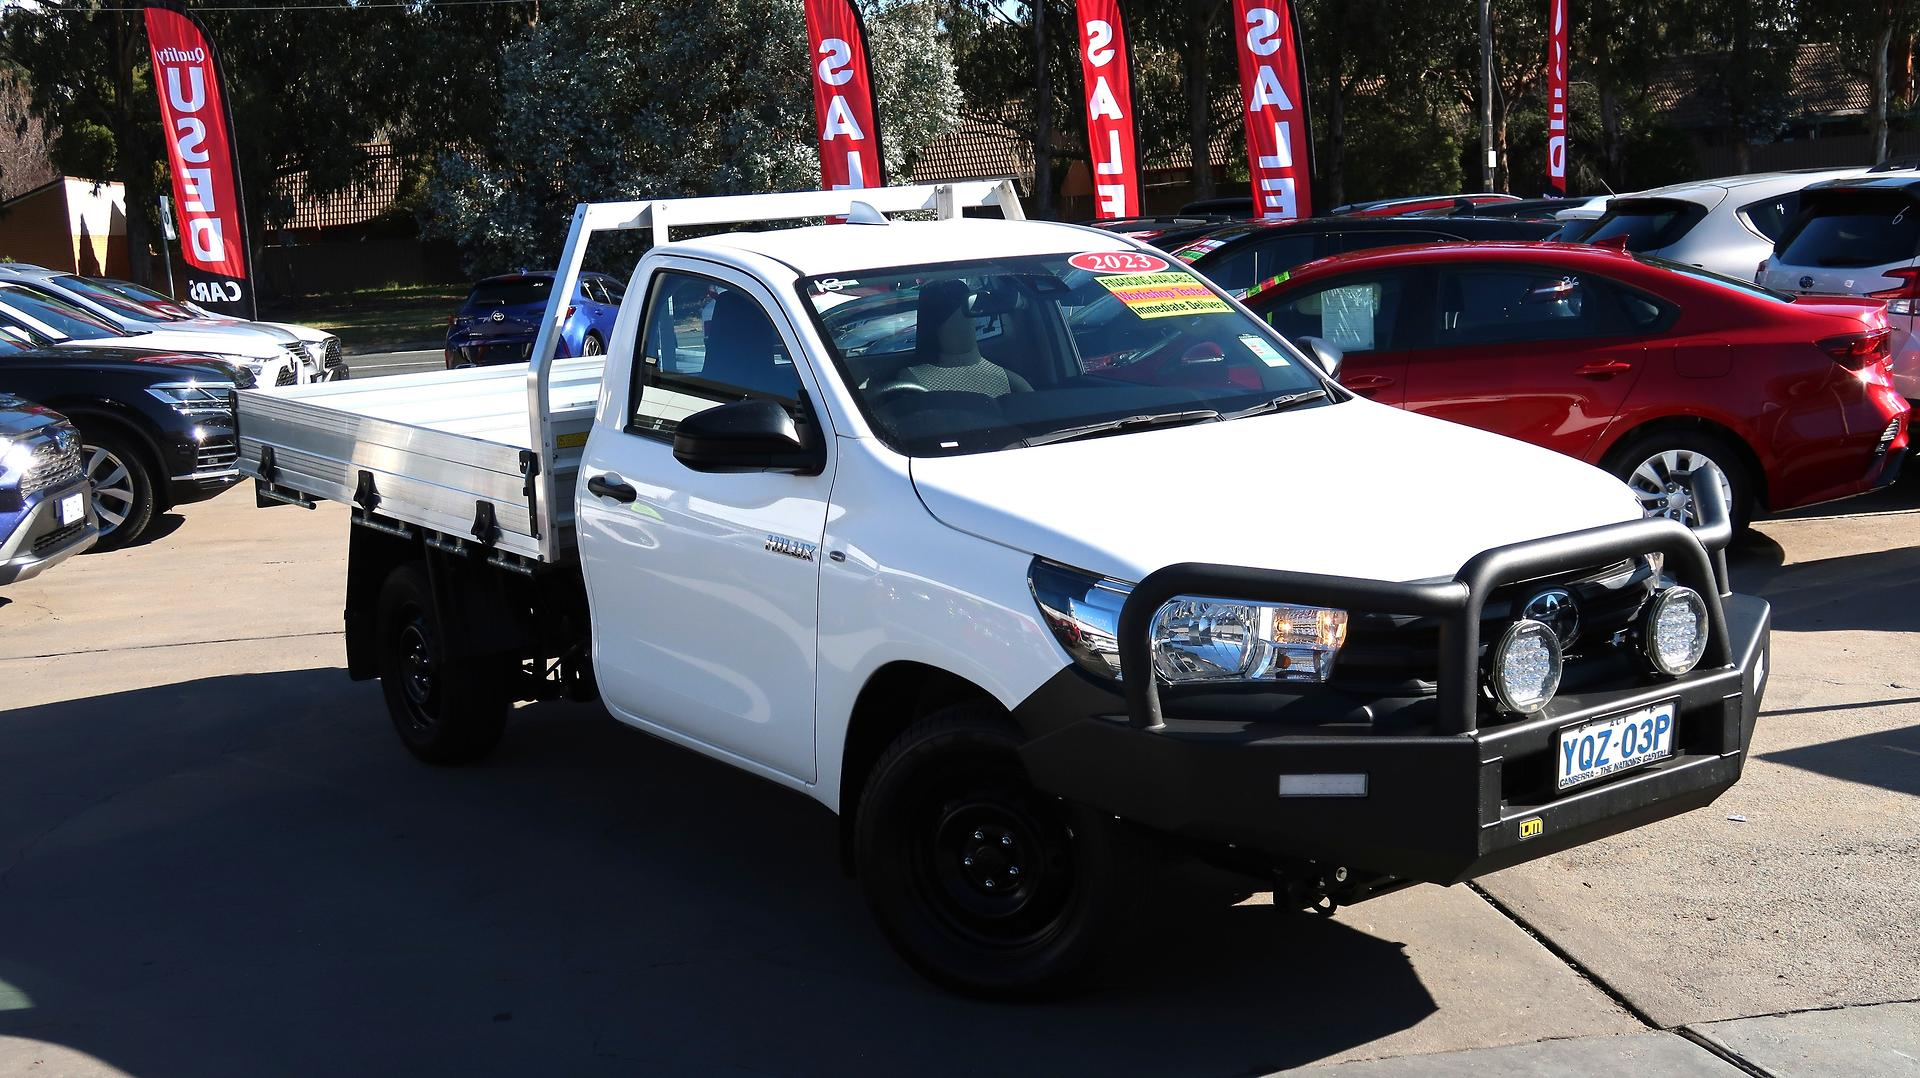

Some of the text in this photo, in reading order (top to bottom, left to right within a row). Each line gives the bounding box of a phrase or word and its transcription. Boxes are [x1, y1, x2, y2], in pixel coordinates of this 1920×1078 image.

[1087, 254, 1151, 270] 2023
[1101, 273, 1197, 289] FINANCING AVAILABLE
[1117, 288, 1175, 301] Workshop
[1131, 300, 1230, 315] Immediate Delivery
[765, 535, 816, 562] HILUX
[1560, 771, 1594, 787] CANBERRA
[1600, 764, 1613, 777] THE
[1643, 749, 1667, 762] CAPITAL
